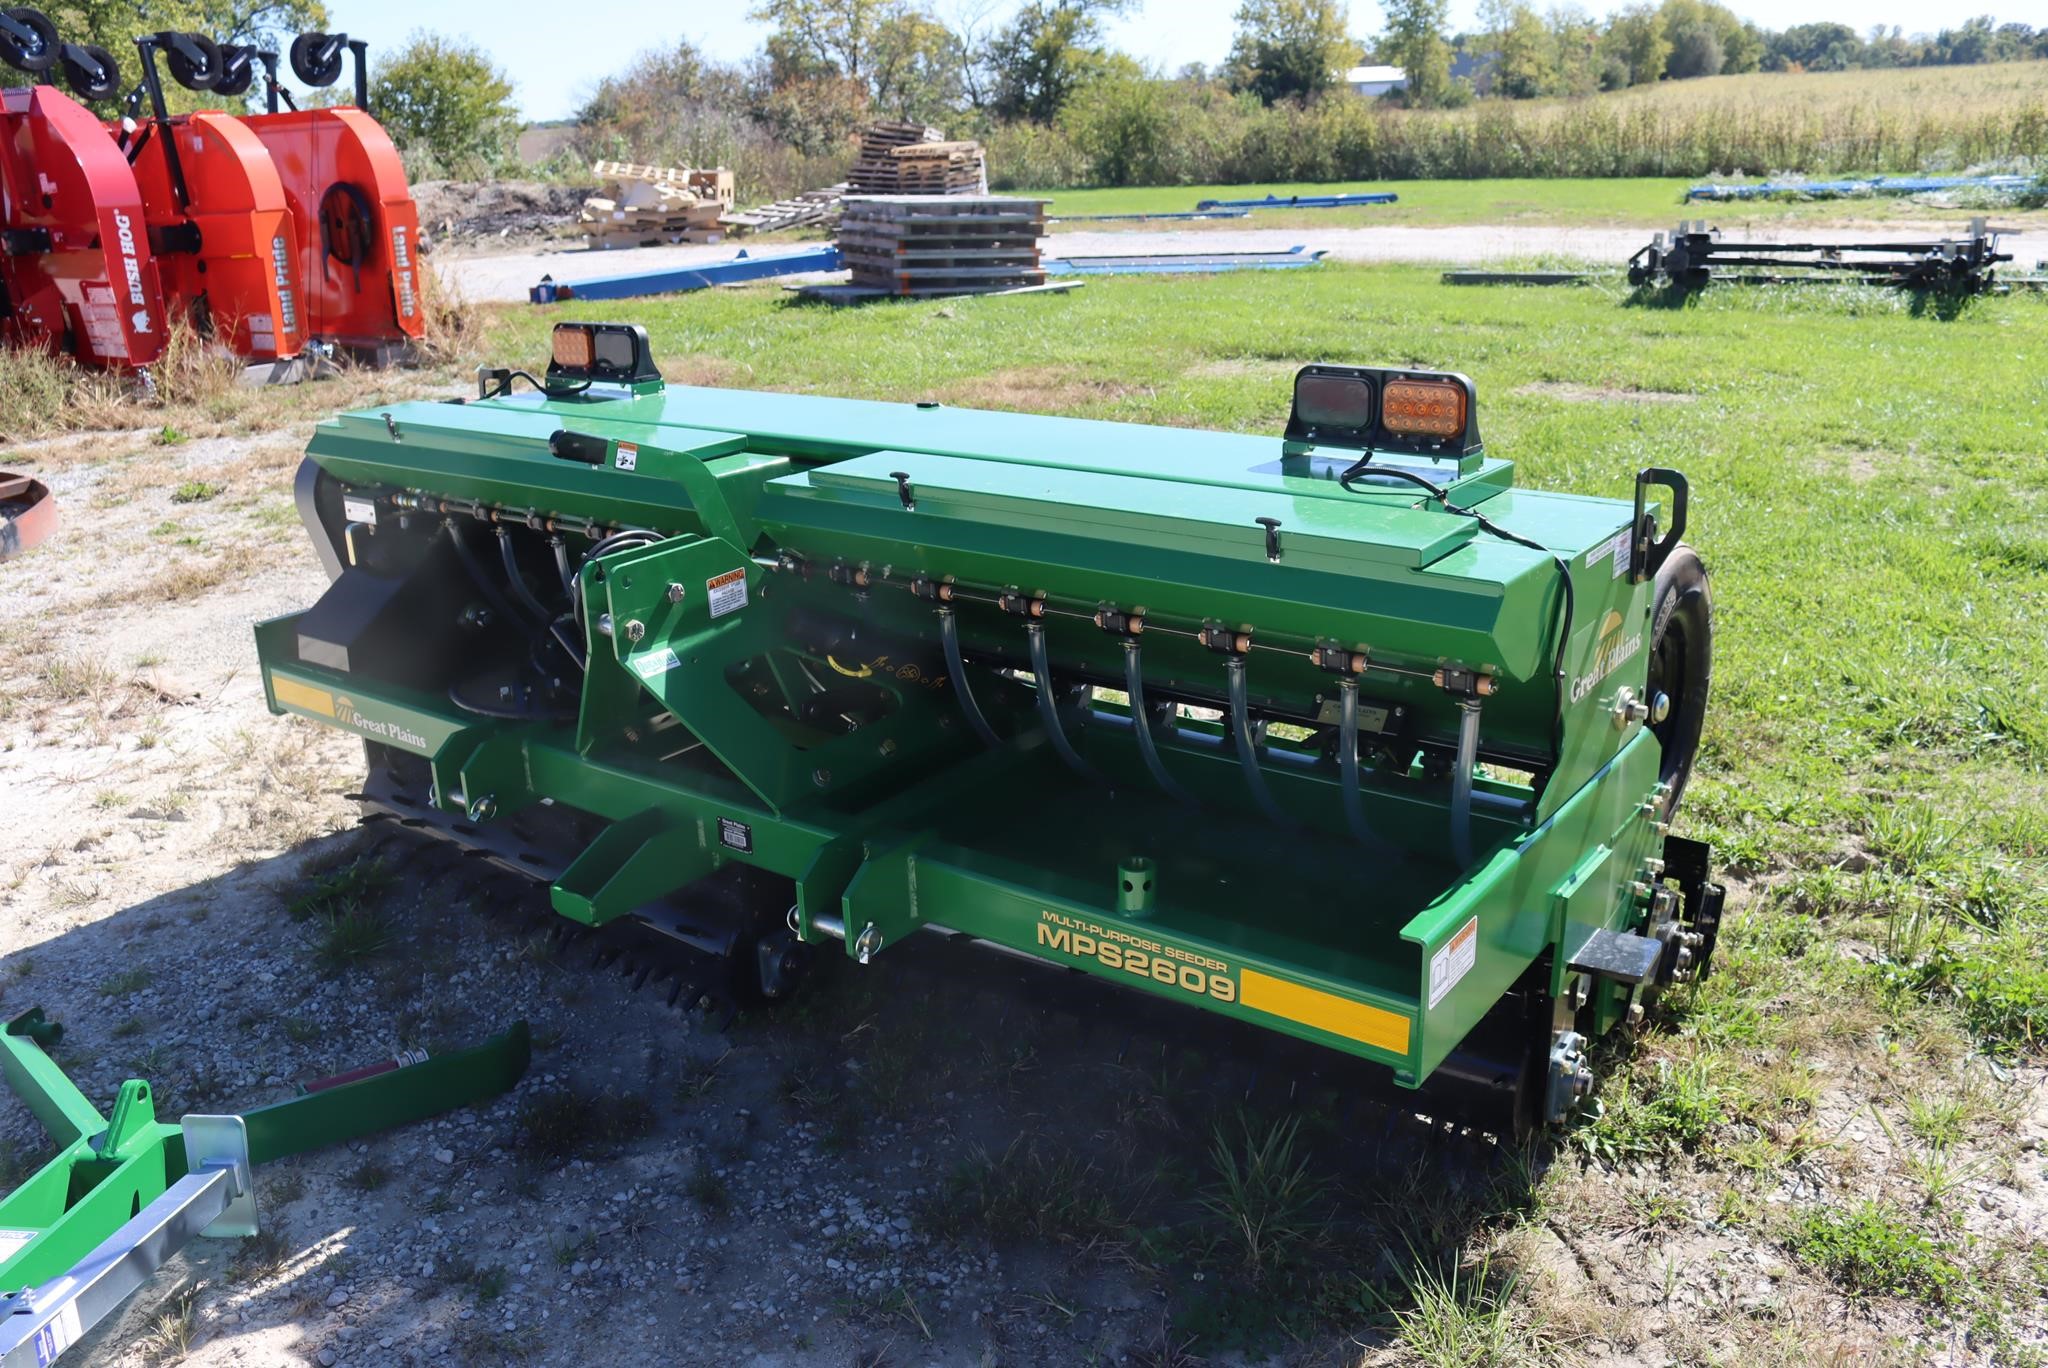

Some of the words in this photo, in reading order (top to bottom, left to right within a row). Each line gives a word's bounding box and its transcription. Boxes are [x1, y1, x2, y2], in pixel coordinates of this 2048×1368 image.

[115, 214, 136, 255] HOG
[393, 226, 410, 267] Land
[124, 257, 145, 306] BUSH
[272, 236, 290, 286] Pride
[277, 290, 296, 333] Land
[398, 271, 415, 317] Pride
[1571, 661, 1605, 704] Great
[1608, 633, 1641, 674] Plains
[353, 711, 387, 736] Great
[387, 722, 427, 749] Plains
[1037, 922, 1236, 1003] MPS2609
[1042, 910, 1161, 954] MULTI-PURPOSE
[1164, 945, 1228, 974] SEEDER
